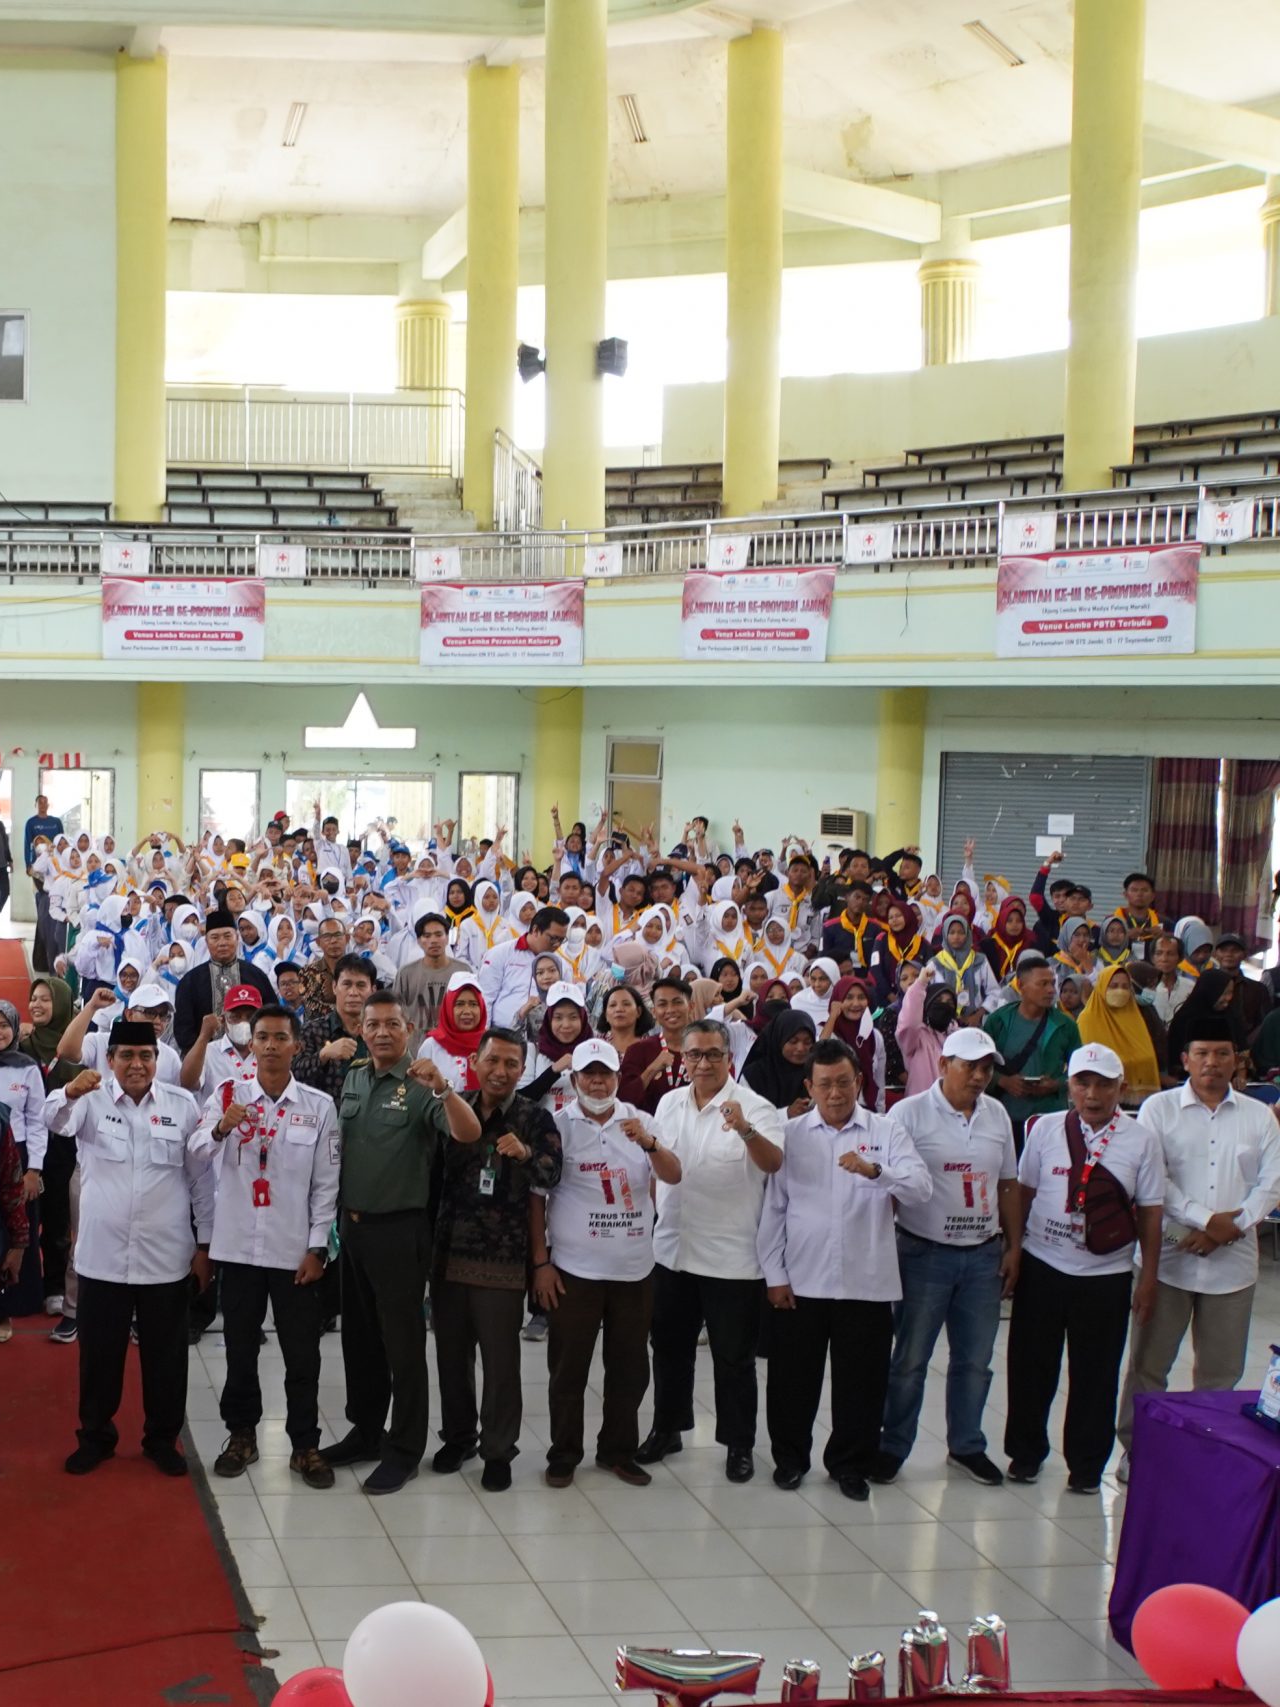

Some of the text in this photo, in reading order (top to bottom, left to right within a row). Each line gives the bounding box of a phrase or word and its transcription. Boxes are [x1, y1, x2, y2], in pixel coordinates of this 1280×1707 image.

[1216, 529, 1234, 538] PMI
[1020, 541, 1038, 549] PMI
[1084, 582, 1152, 601] SE-PROVINSI
[1038, 623, 1063, 632] Venue
[1064, 621, 1091, 631] Lomba
[1118, 618, 1152, 629] Terbuka
[588, 1220, 632, 1228] KEBAIKAN
